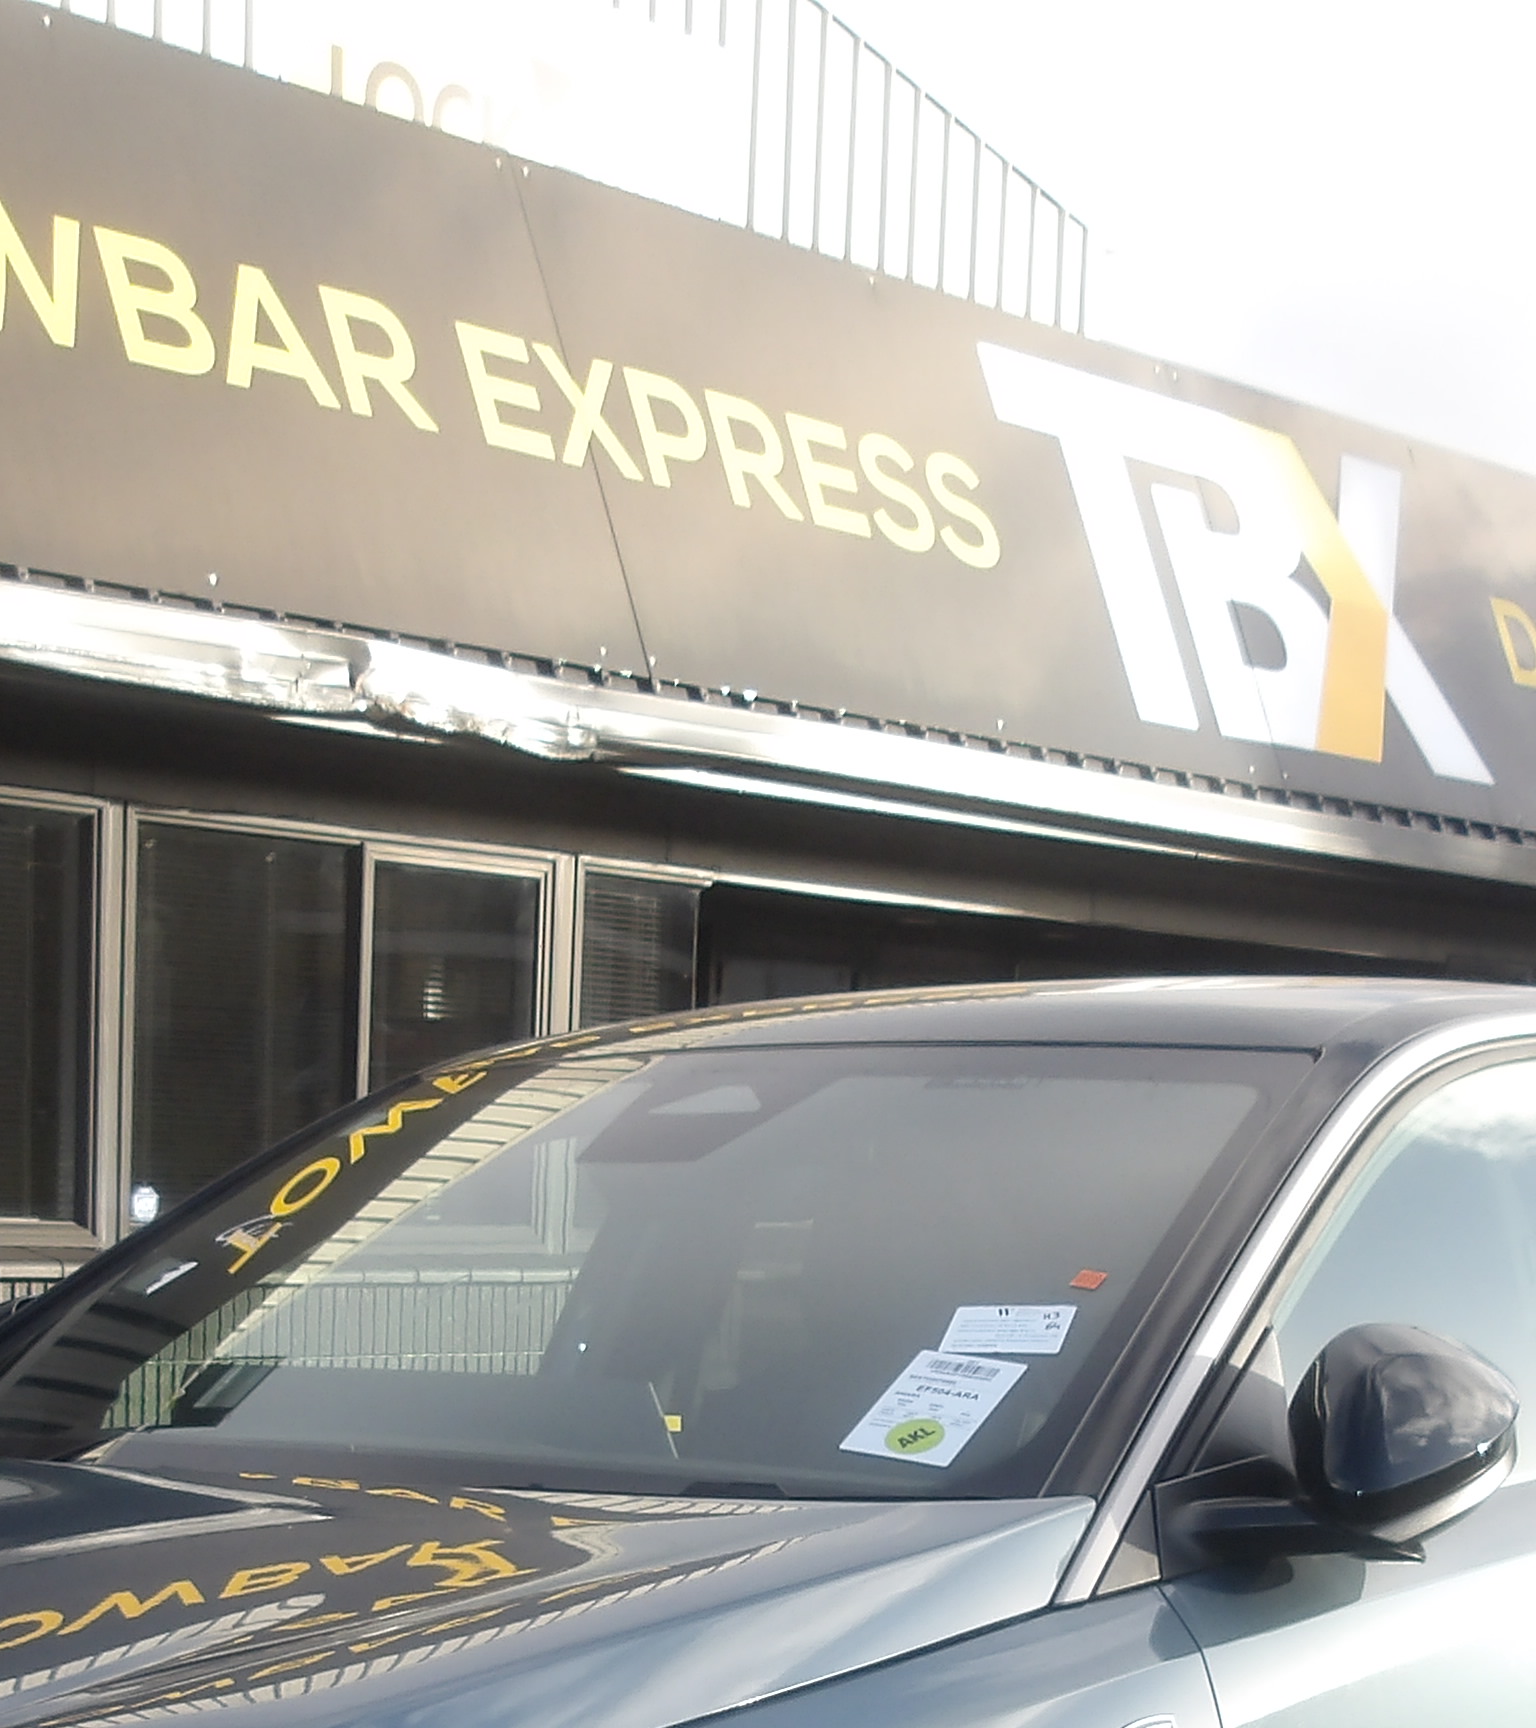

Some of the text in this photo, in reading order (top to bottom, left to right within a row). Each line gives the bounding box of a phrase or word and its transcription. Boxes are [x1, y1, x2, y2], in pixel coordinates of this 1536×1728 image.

[455, 320, 1001, 570] EXPRESS
[976, 341, 1496, 786] TBX
[897, 1427, 936, 1448] AKL
